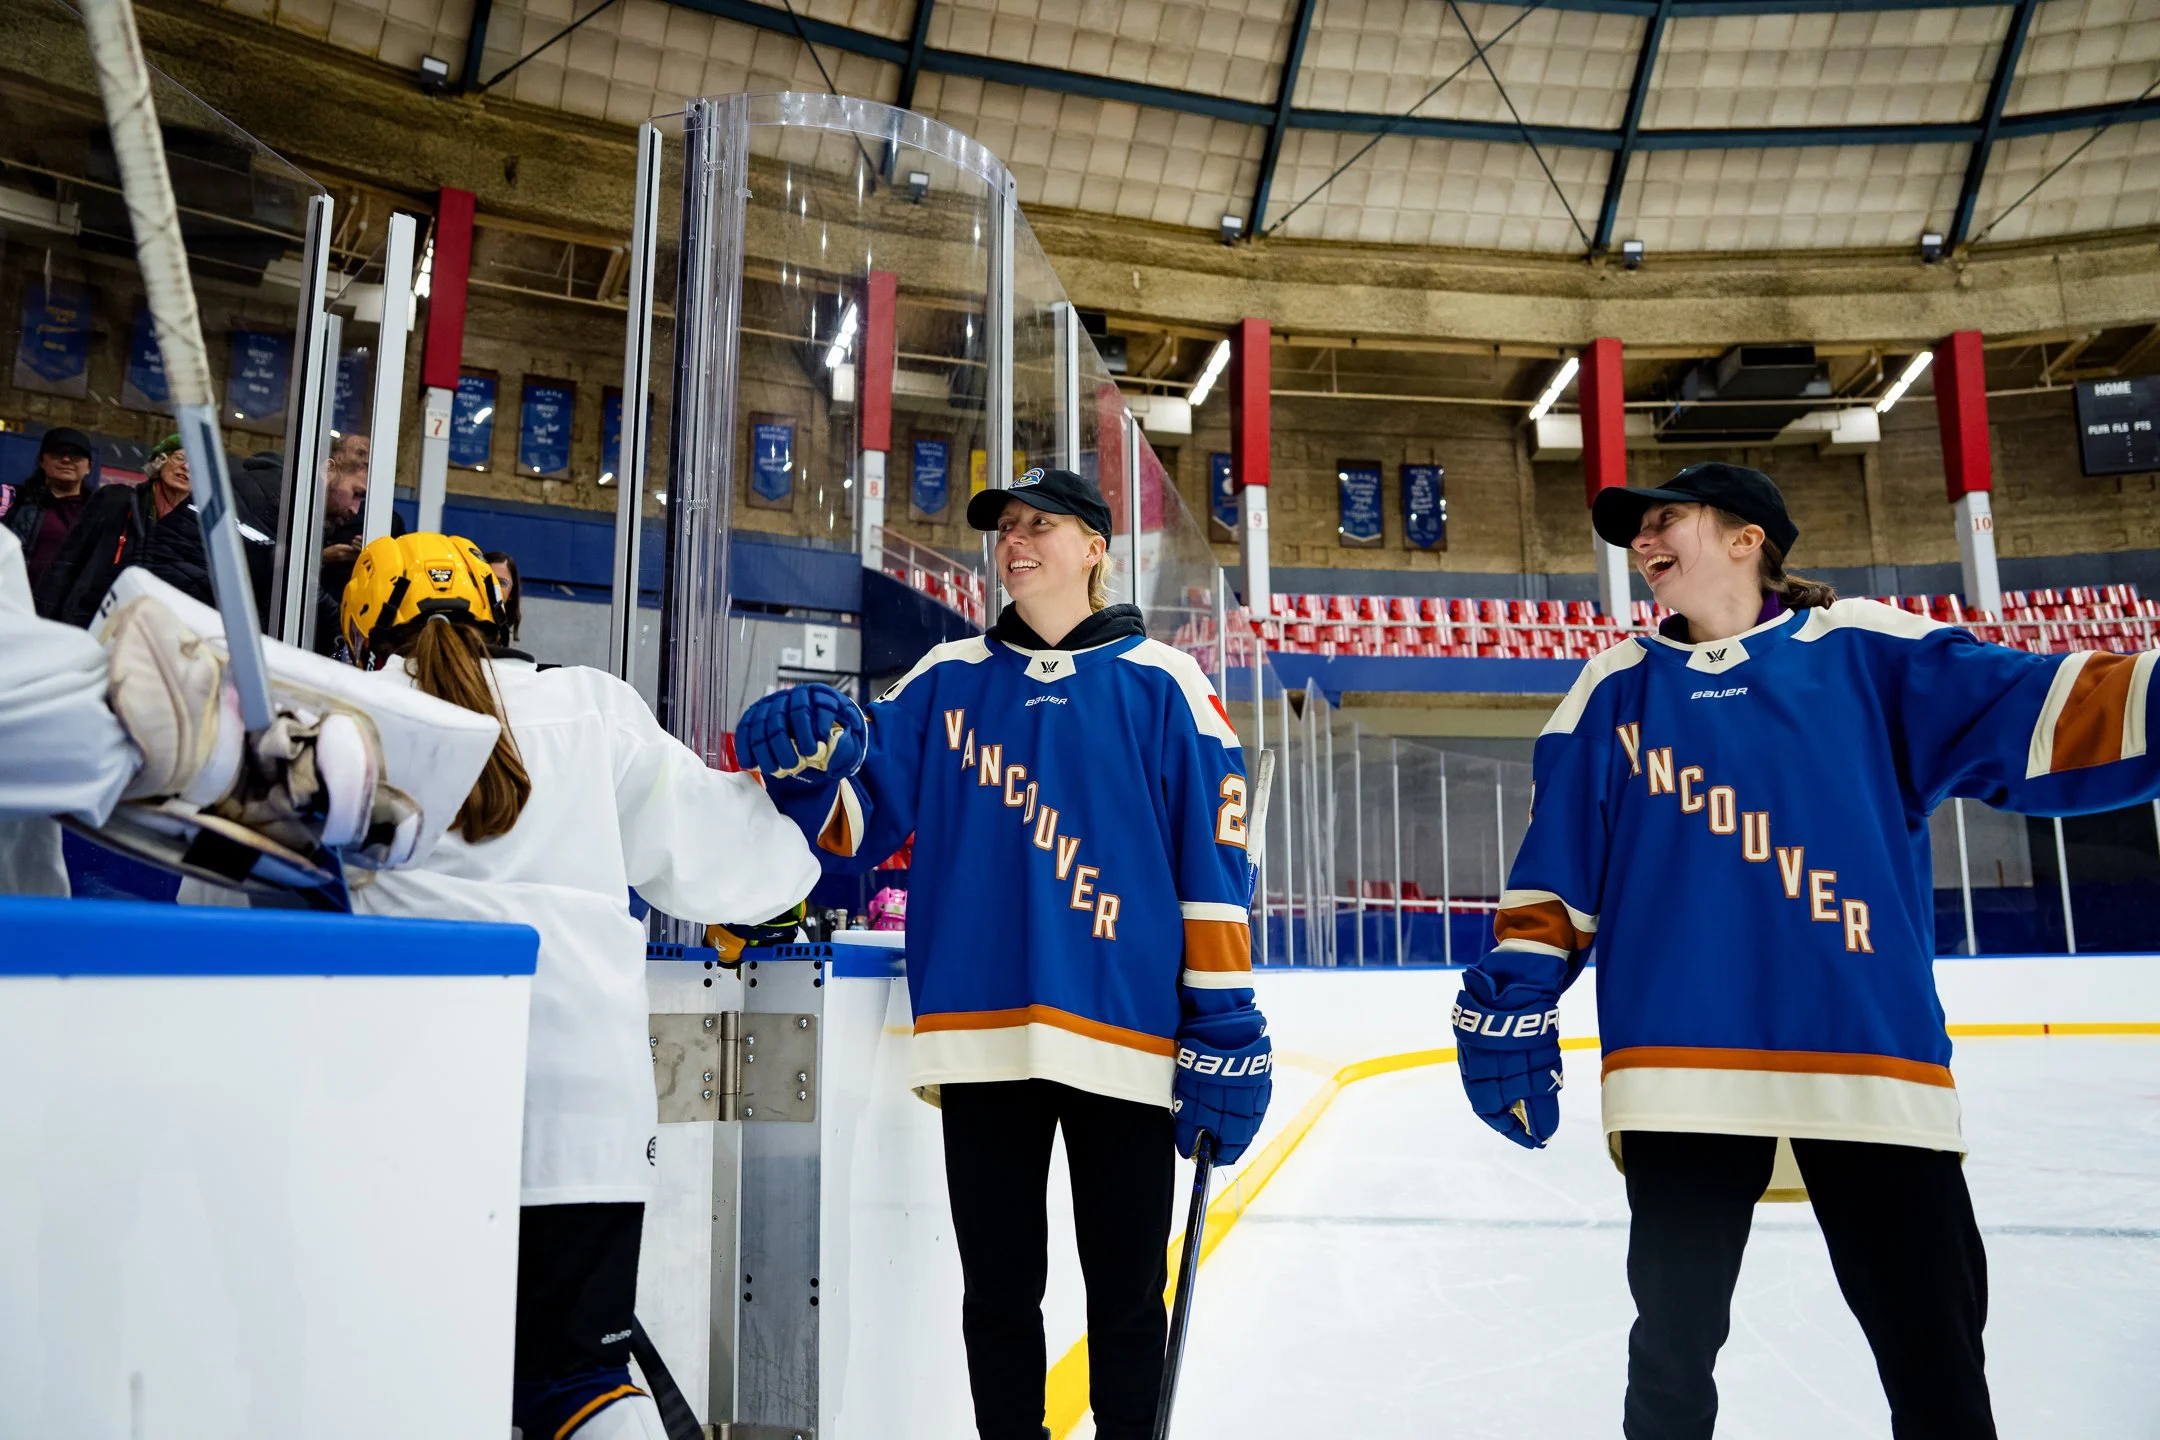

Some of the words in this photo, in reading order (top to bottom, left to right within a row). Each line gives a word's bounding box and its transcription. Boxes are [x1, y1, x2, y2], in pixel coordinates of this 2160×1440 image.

[2094, 381, 2132, 396] HOME
[433, 418, 443, 437] 7
[869, 480, 879, 497] 8
[1252, 511, 1263, 527] 9
[1974, 516, 1992, 531] 10
[1025, 695, 1068, 707] BAUER
[1690, 687, 1748, 700] BAUER
[944, 708, 1120, 941] VANCOUVER
[1615, 721, 1875, 954] VNCOUVER
